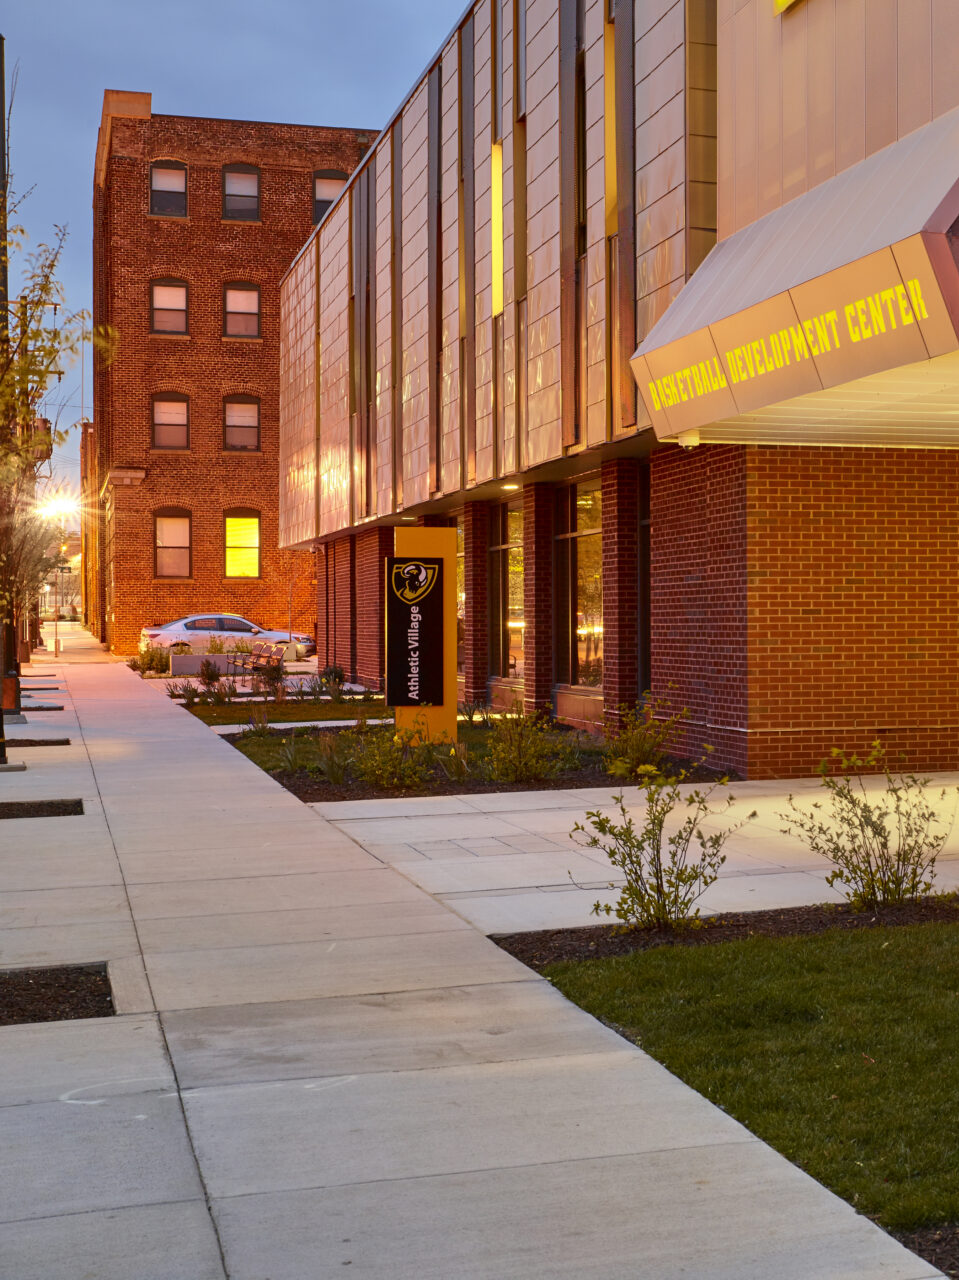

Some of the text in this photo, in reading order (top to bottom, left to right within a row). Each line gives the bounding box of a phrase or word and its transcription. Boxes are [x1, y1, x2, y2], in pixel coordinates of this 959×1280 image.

[648, 278, 929, 412] BASKETBALL DEVELOPMENT CENTER
[407, 605, 422, 700] Athletic Village
